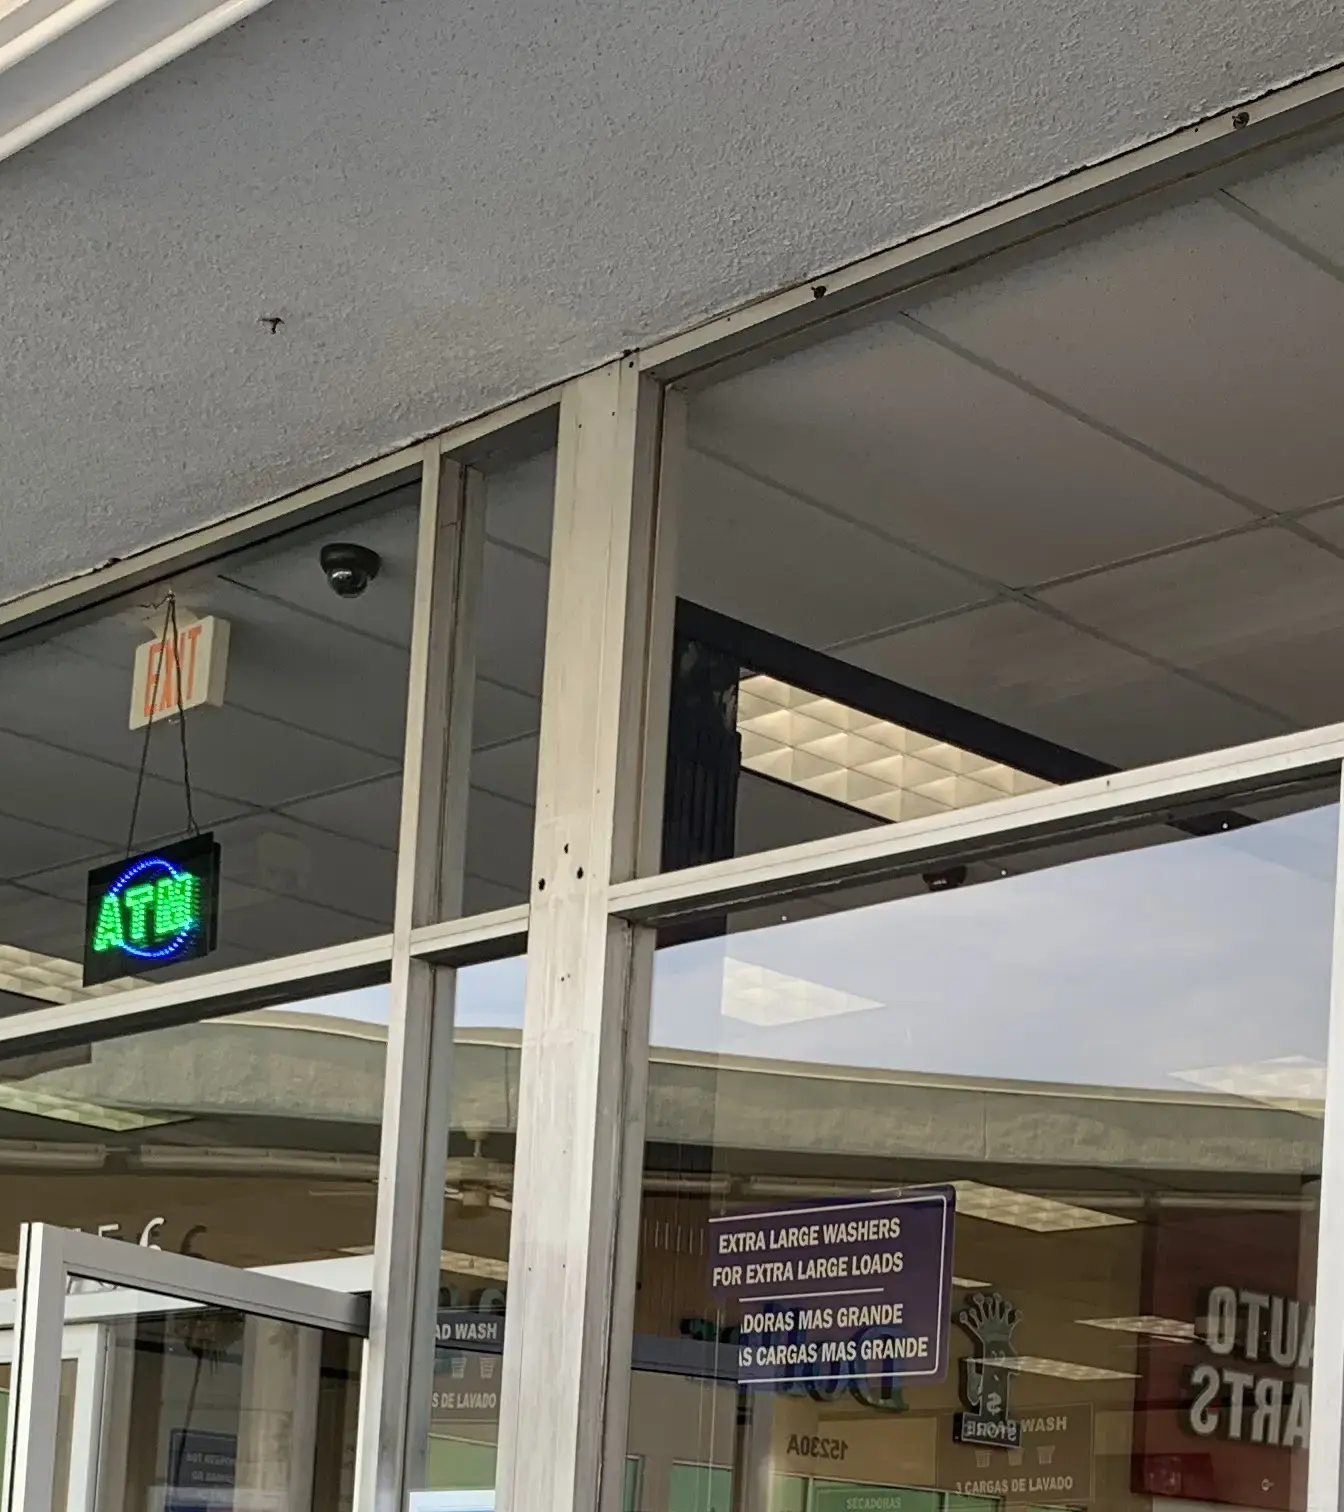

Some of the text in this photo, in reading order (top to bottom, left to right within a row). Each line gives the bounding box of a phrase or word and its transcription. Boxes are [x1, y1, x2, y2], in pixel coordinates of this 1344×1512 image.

[93, 872, 197, 952] ATM
[719, 1217, 902, 1255] EXTRA LARGE WASHERS
[712, 1251, 904, 1288] FOR EXTRA LARGE LOADS
[455, 1322, 498, 1340] WASH
[798, 1307, 834, 1331] MAS
[836, 1303, 904, 1328] GRANDE
[755, 1342, 819, 1367] CARGAS
[821, 1338, 857, 1362] MAS
[860, 1336, 928, 1360] GRANDE
[441, 1393, 455, 1409] DE
[457, 1392, 497, 1409] LAVADO
[1021, 1416, 1068, 1433] WASH
[964, 1479, 1009, 1494] CARGAS
[1011, 1478, 1026, 1492] DE
[1029, 1476, 1073, 1490] LAVADO
